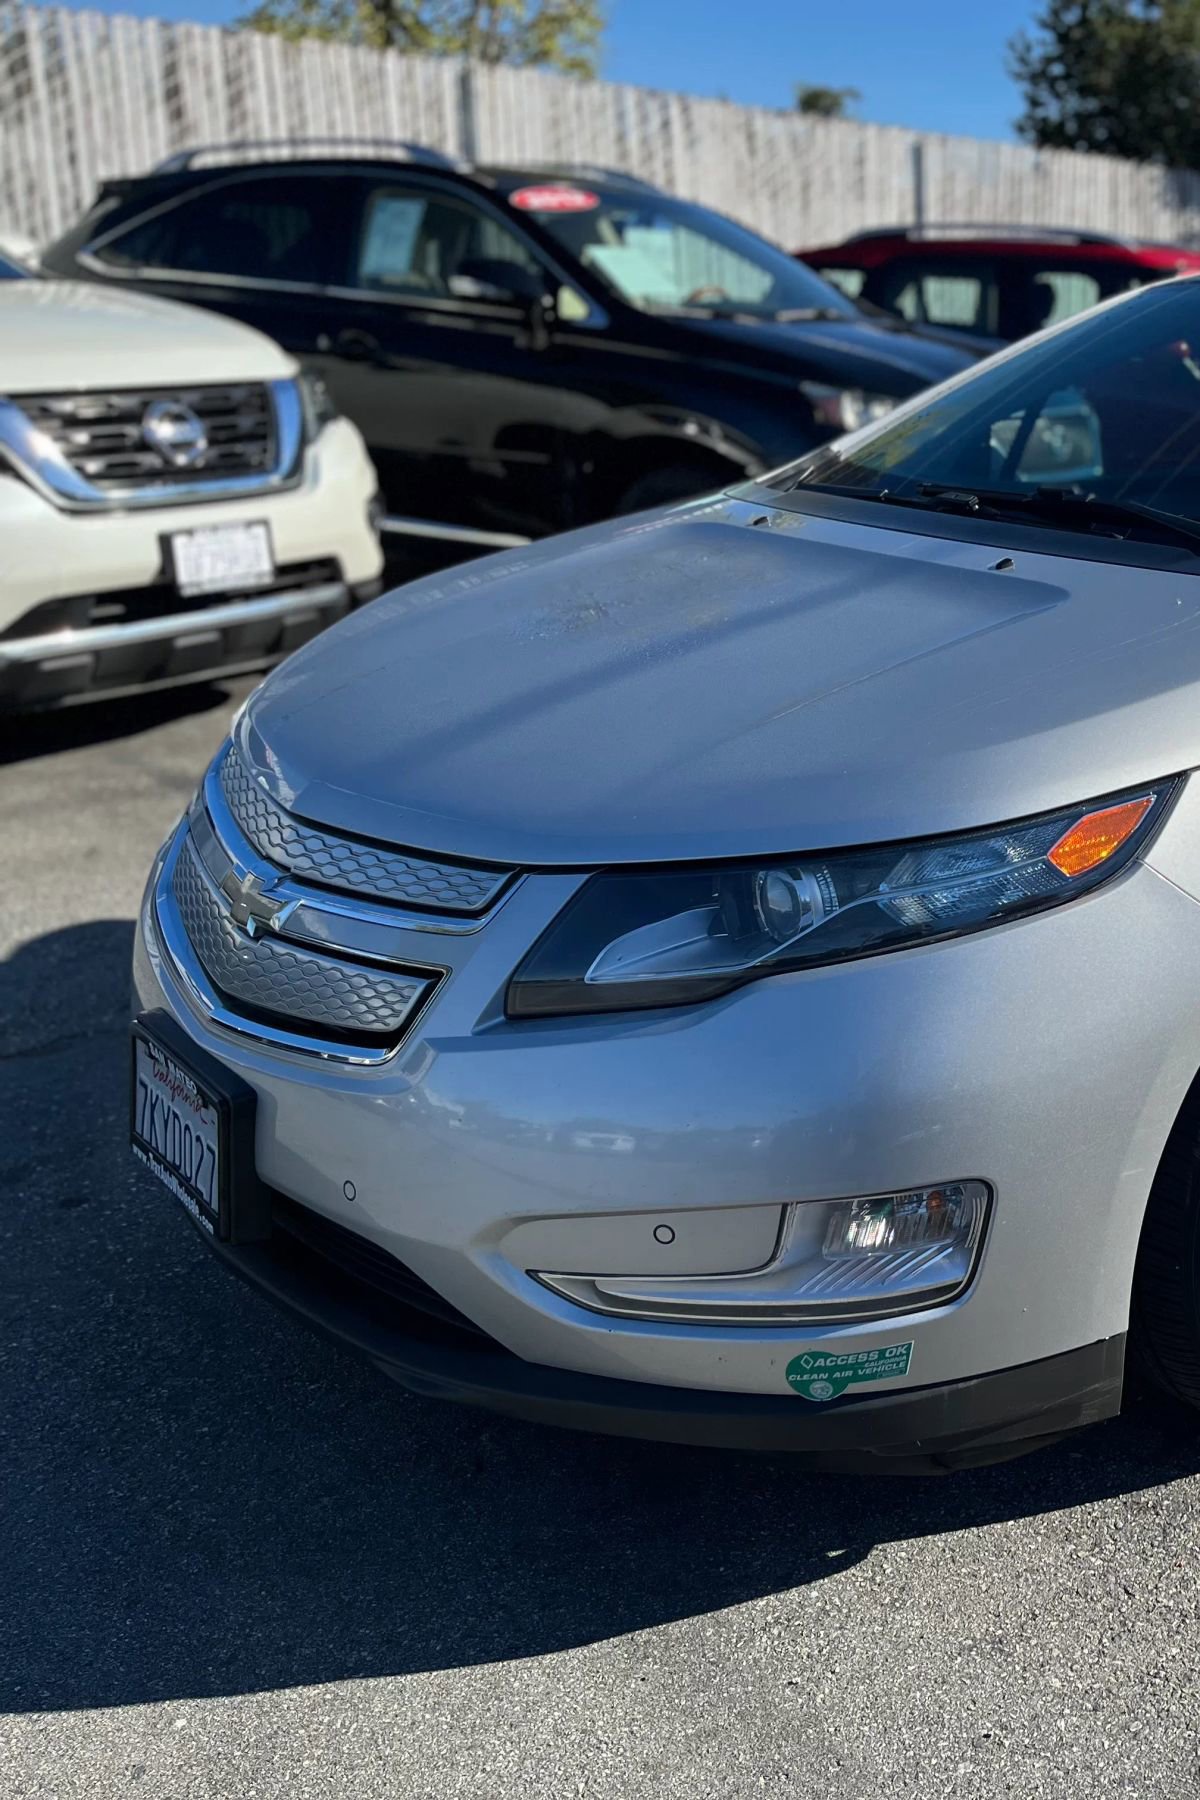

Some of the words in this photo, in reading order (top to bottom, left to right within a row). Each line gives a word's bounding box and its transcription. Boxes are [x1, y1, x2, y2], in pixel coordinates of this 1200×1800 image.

[152, 1061, 208, 1125] California
[138, 1077, 216, 1208] 7KYD027
[814, 1351, 879, 1368] ACCESS
[885, 1344, 908, 1357] OK
[864, 1355, 907, 1368] CALIFORNIA
[788, 1373, 829, 1381] CLEAN
[832, 1370, 854, 1378] AIR
[858, 1361, 906, 1376] VEHICLE
